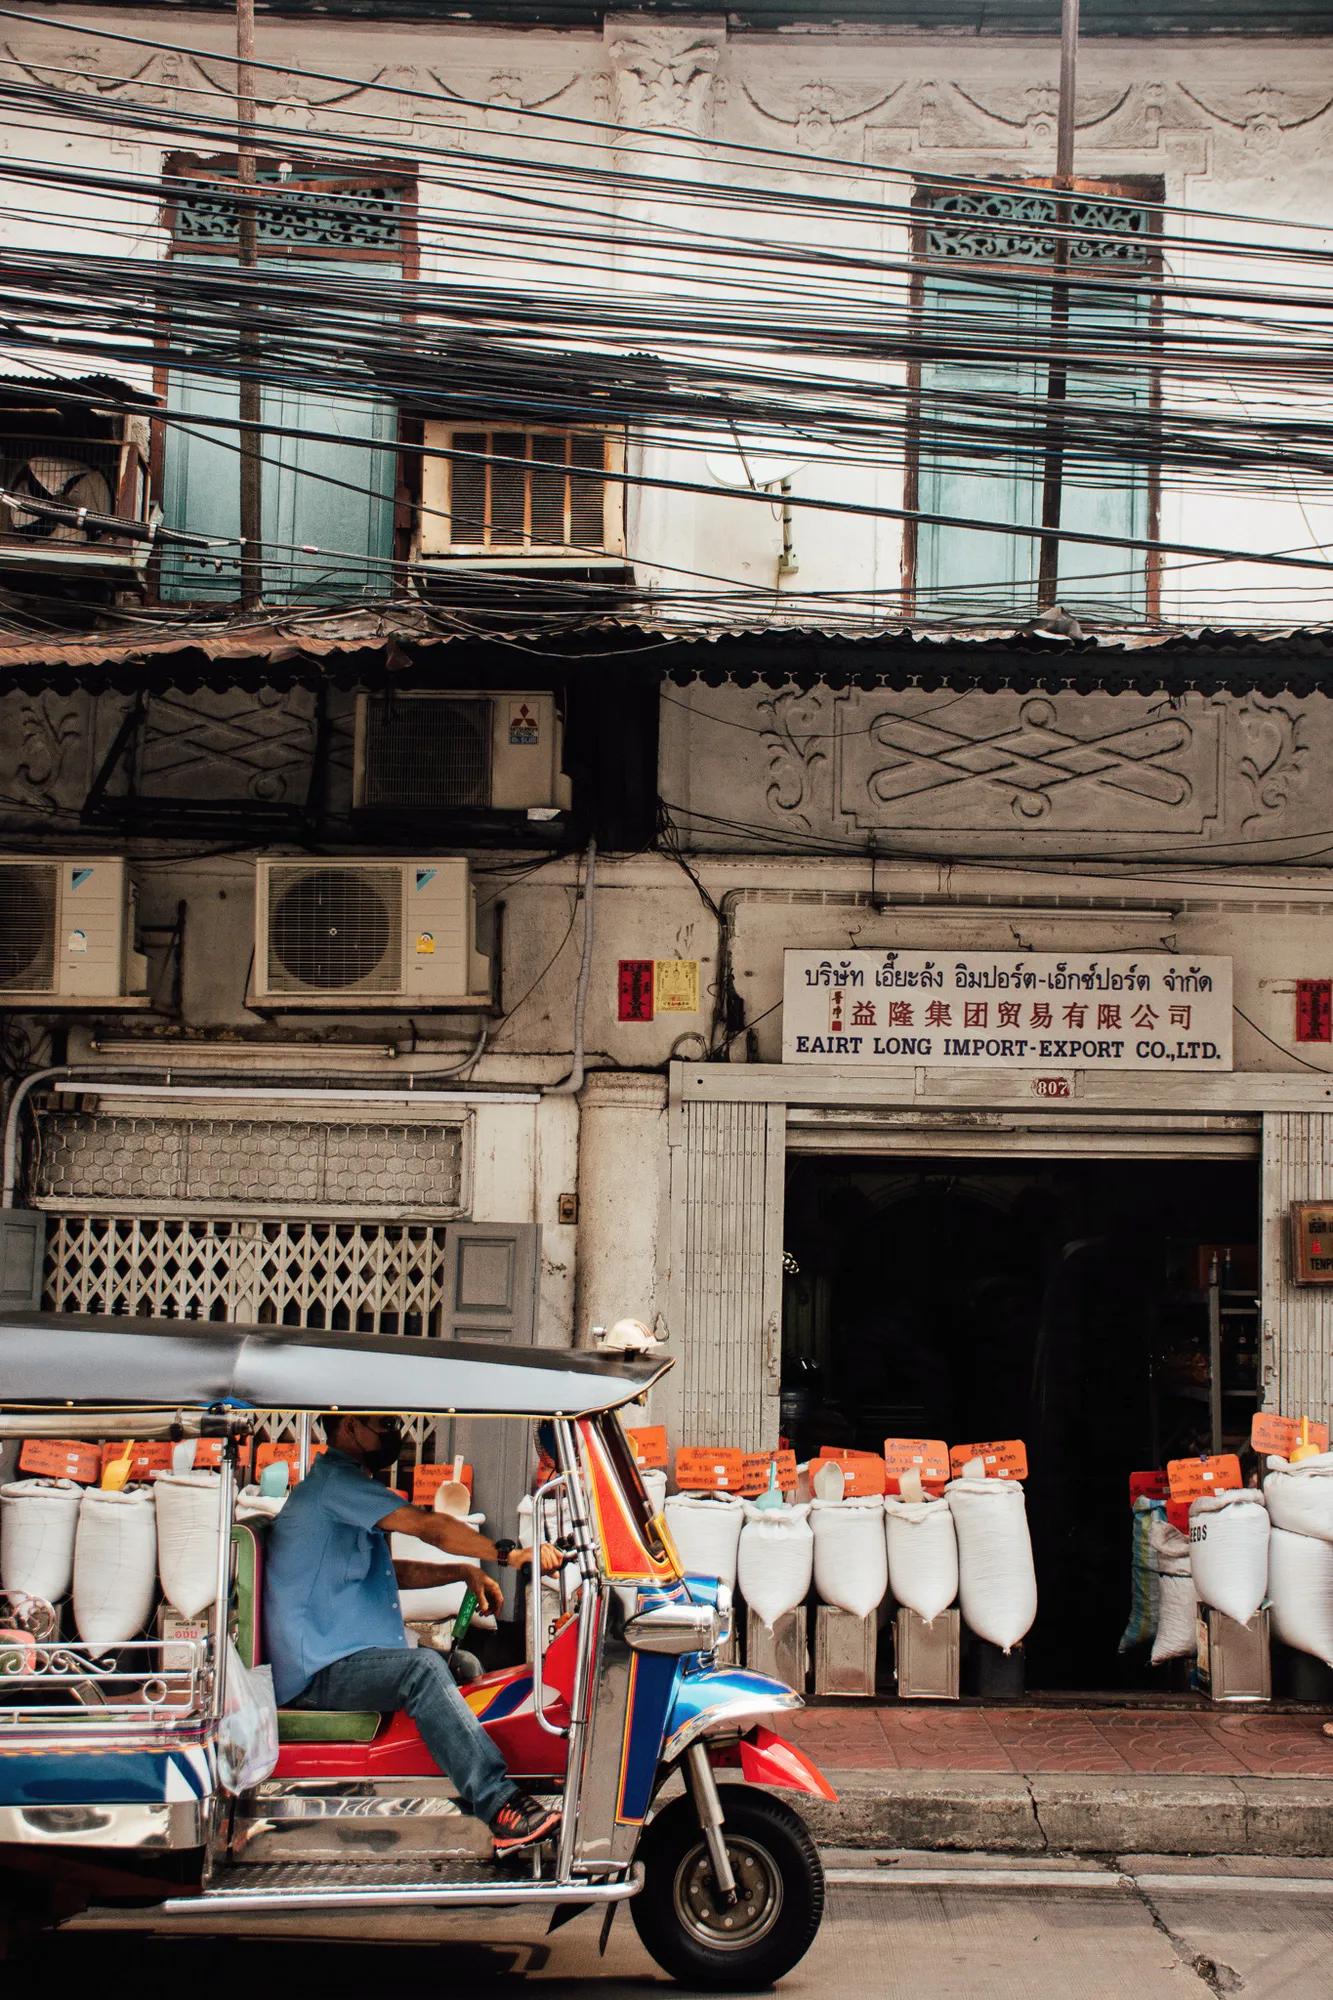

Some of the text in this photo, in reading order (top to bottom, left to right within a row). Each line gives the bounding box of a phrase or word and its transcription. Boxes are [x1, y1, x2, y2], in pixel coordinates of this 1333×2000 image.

[804, 960, 864, 987] บริษัท
[1162, 966, 1213, 993] จำกัด
[850, 1000, 1192, 1031] 益隆集团贸易有限公司
[796, 1036, 1221, 1062] EAIRT LONG IMPORT-EXPORT CO.,LTD.
[1036, 1080, 1069, 1096] 807
